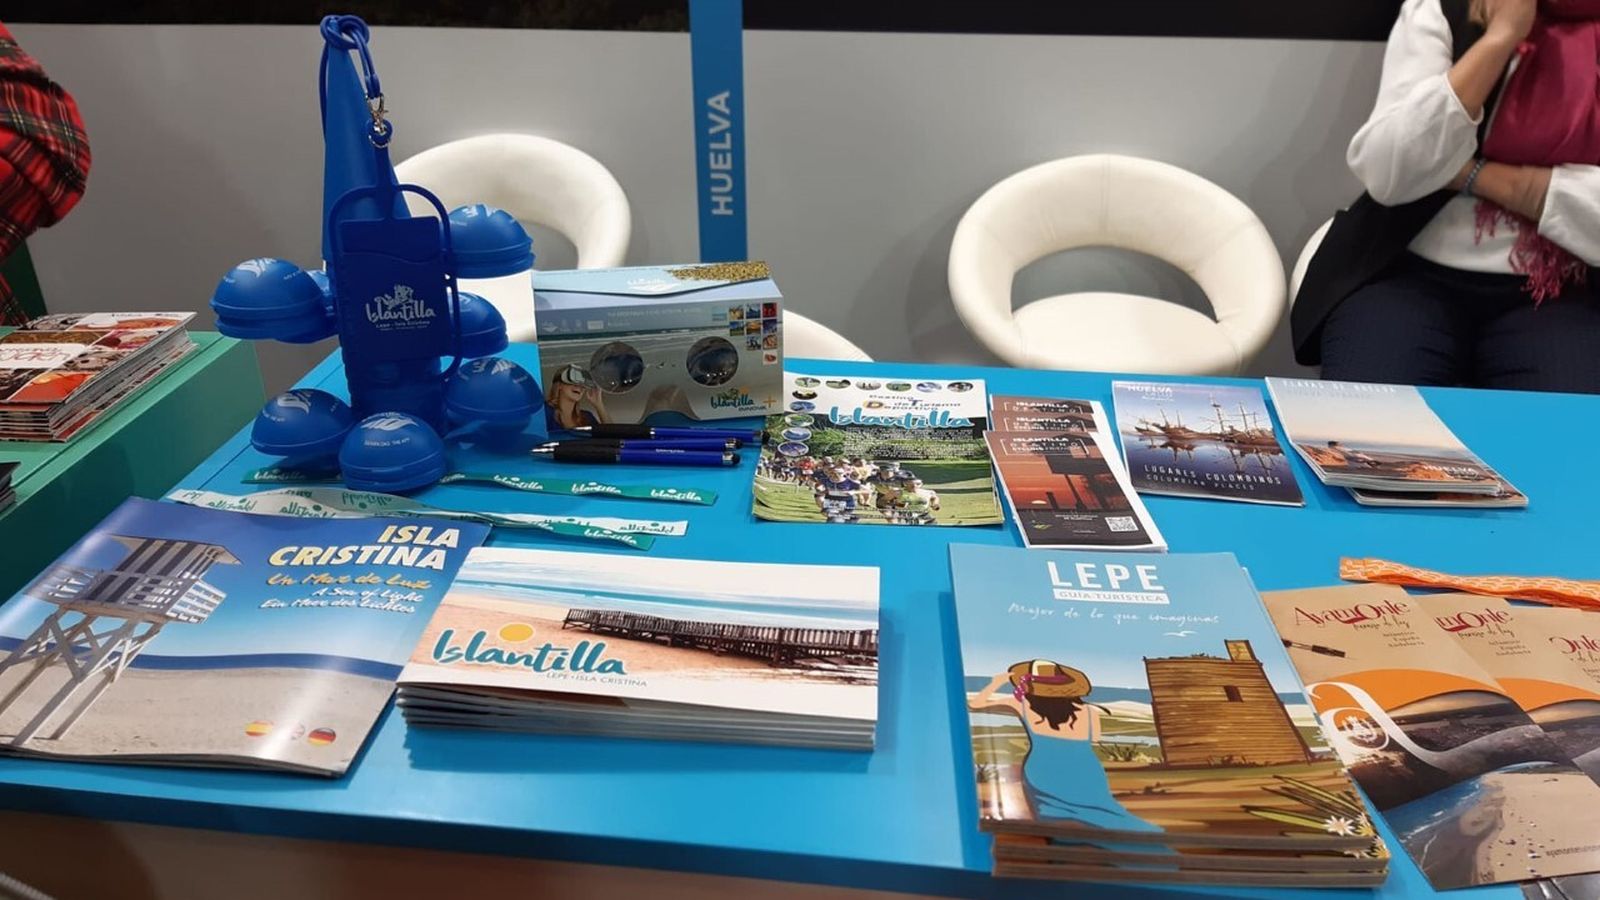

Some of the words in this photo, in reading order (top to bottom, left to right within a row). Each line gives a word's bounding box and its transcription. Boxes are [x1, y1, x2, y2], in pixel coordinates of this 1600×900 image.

[706, 90, 733, 216] HUELVA
[365, 299, 437, 324] Islantilla
[828, 405, 975, 430] Islantilla
[1144, 464, 1197, 478] LUGARES
[1205, 472, 1282, 486] COLOMBINOS
[377, 525, 461, 548] ISLA
[268, 545, 448, 570] CRISTINA
[354, 572, 382, 585] de
[1047, 560, 1165, 591] LEPE
[433, 628, 629, 676] Islantilla
[547, 672, 568, 680] LEPE
[575, 674, 598, 682] ISLA
[600, 676, 648, 687] CRISTINA
